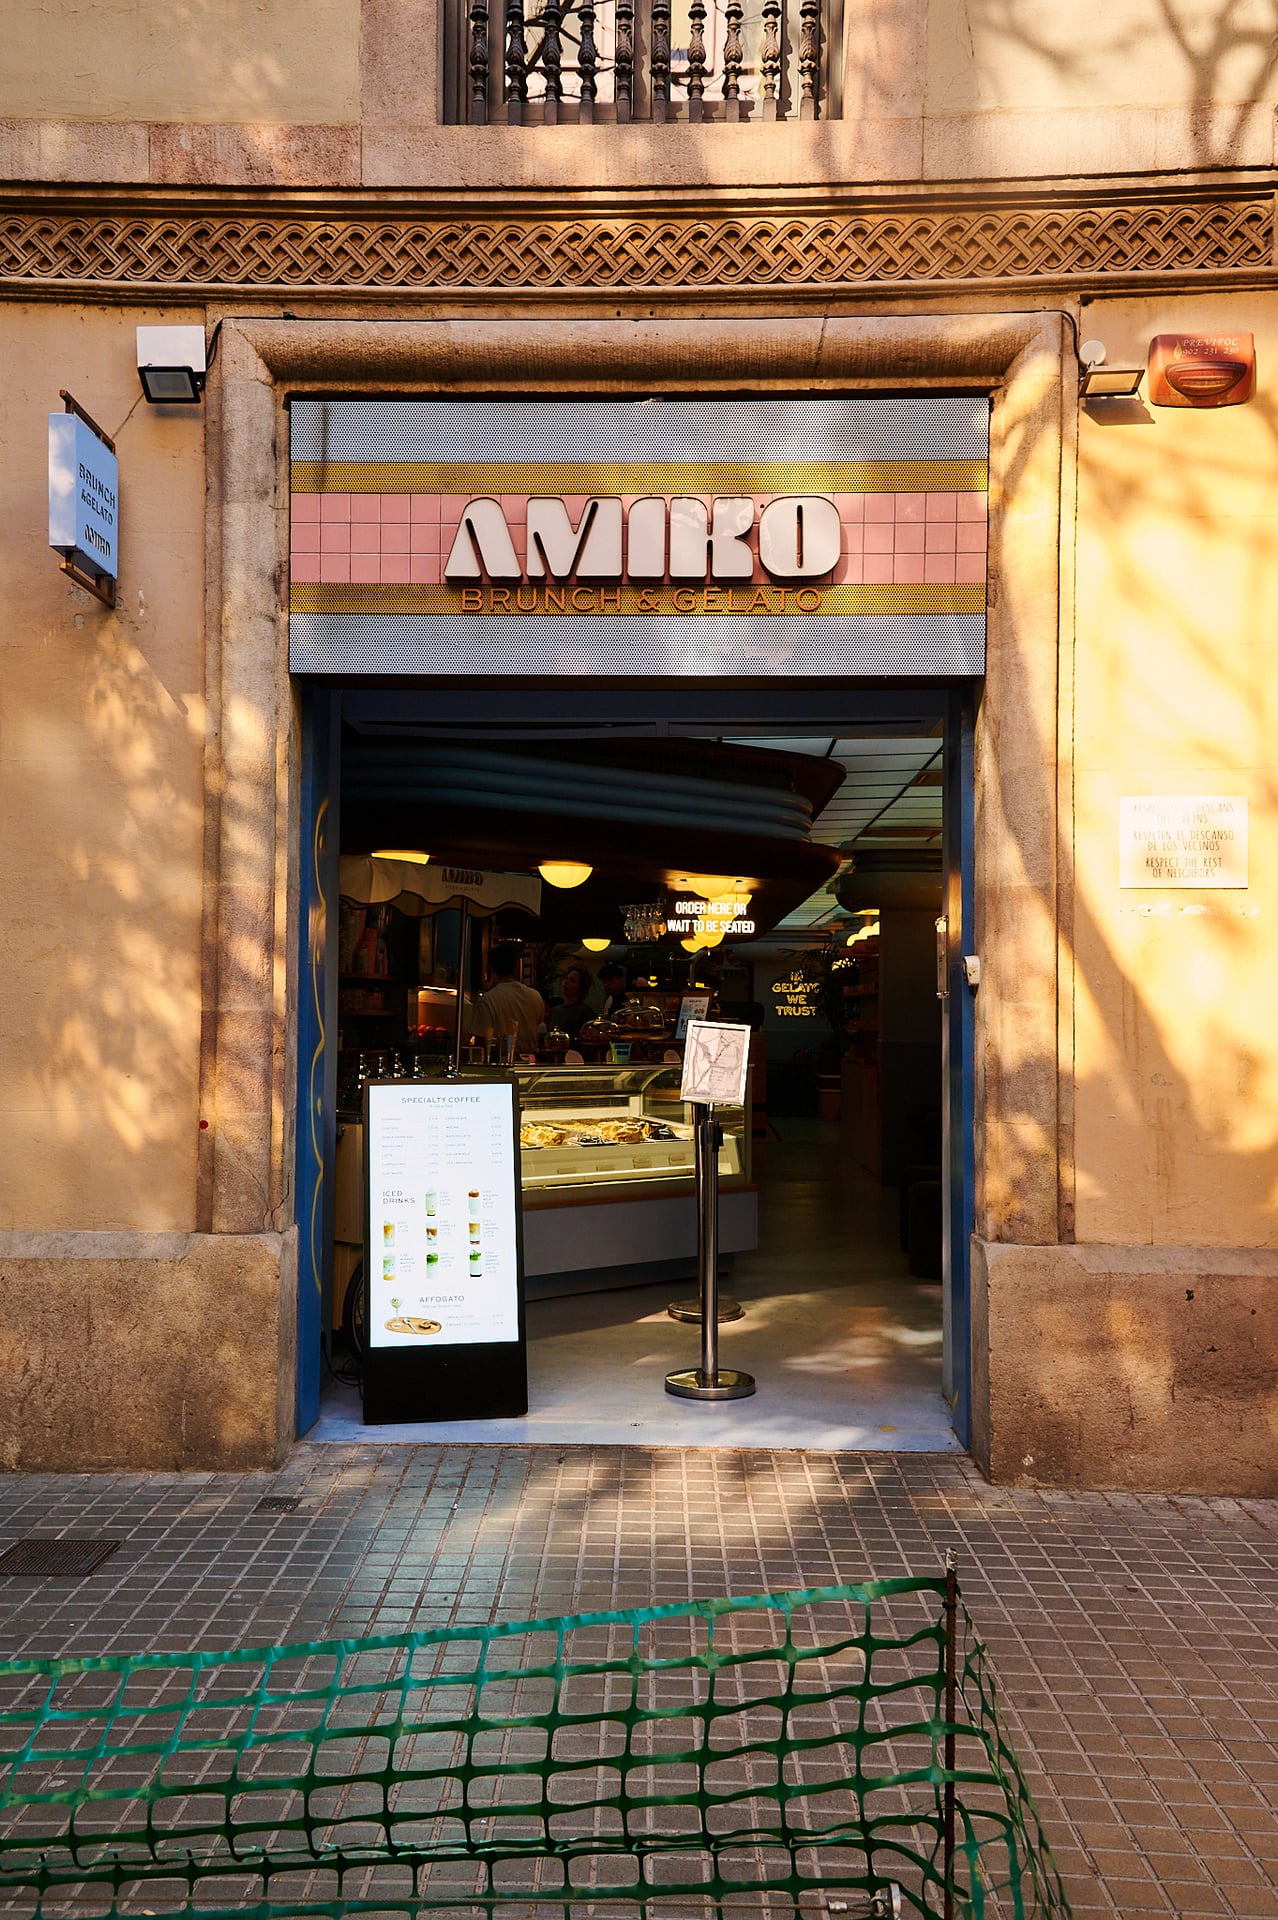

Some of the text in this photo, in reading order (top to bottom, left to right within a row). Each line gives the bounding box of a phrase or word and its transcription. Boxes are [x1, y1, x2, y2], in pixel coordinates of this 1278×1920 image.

[1182, 347, 1239, 357] 902 231 230
[79, 463, 116, 510] BRUNCH
[444, 496, 842, 580] AMIKO
[461, 586, 823, 613] BRUNCH & GELATO
[1191, 830, 1234, 840] DESCANSO
[1148, 841, 1220, 851] DE LOS VECINOS
[1145, 857, 1222, 868] RESPECT THE REST
[1152, 868, 1215, 879] OF NEIGHBORS
[675, 901, 747, 916] ORDER HERE OR
[667, 919, 755, 934] WAIT TO BE SEATED
[786, 994, 808, 1005] WE
[775, 1005, 818, 1016] TRUST
[401, 1096, 446, 1104] SPECIALTY
[382, 1197, 416, 1205] DRINKS
[419, 1295, 465, 1303] AFFOGATO
